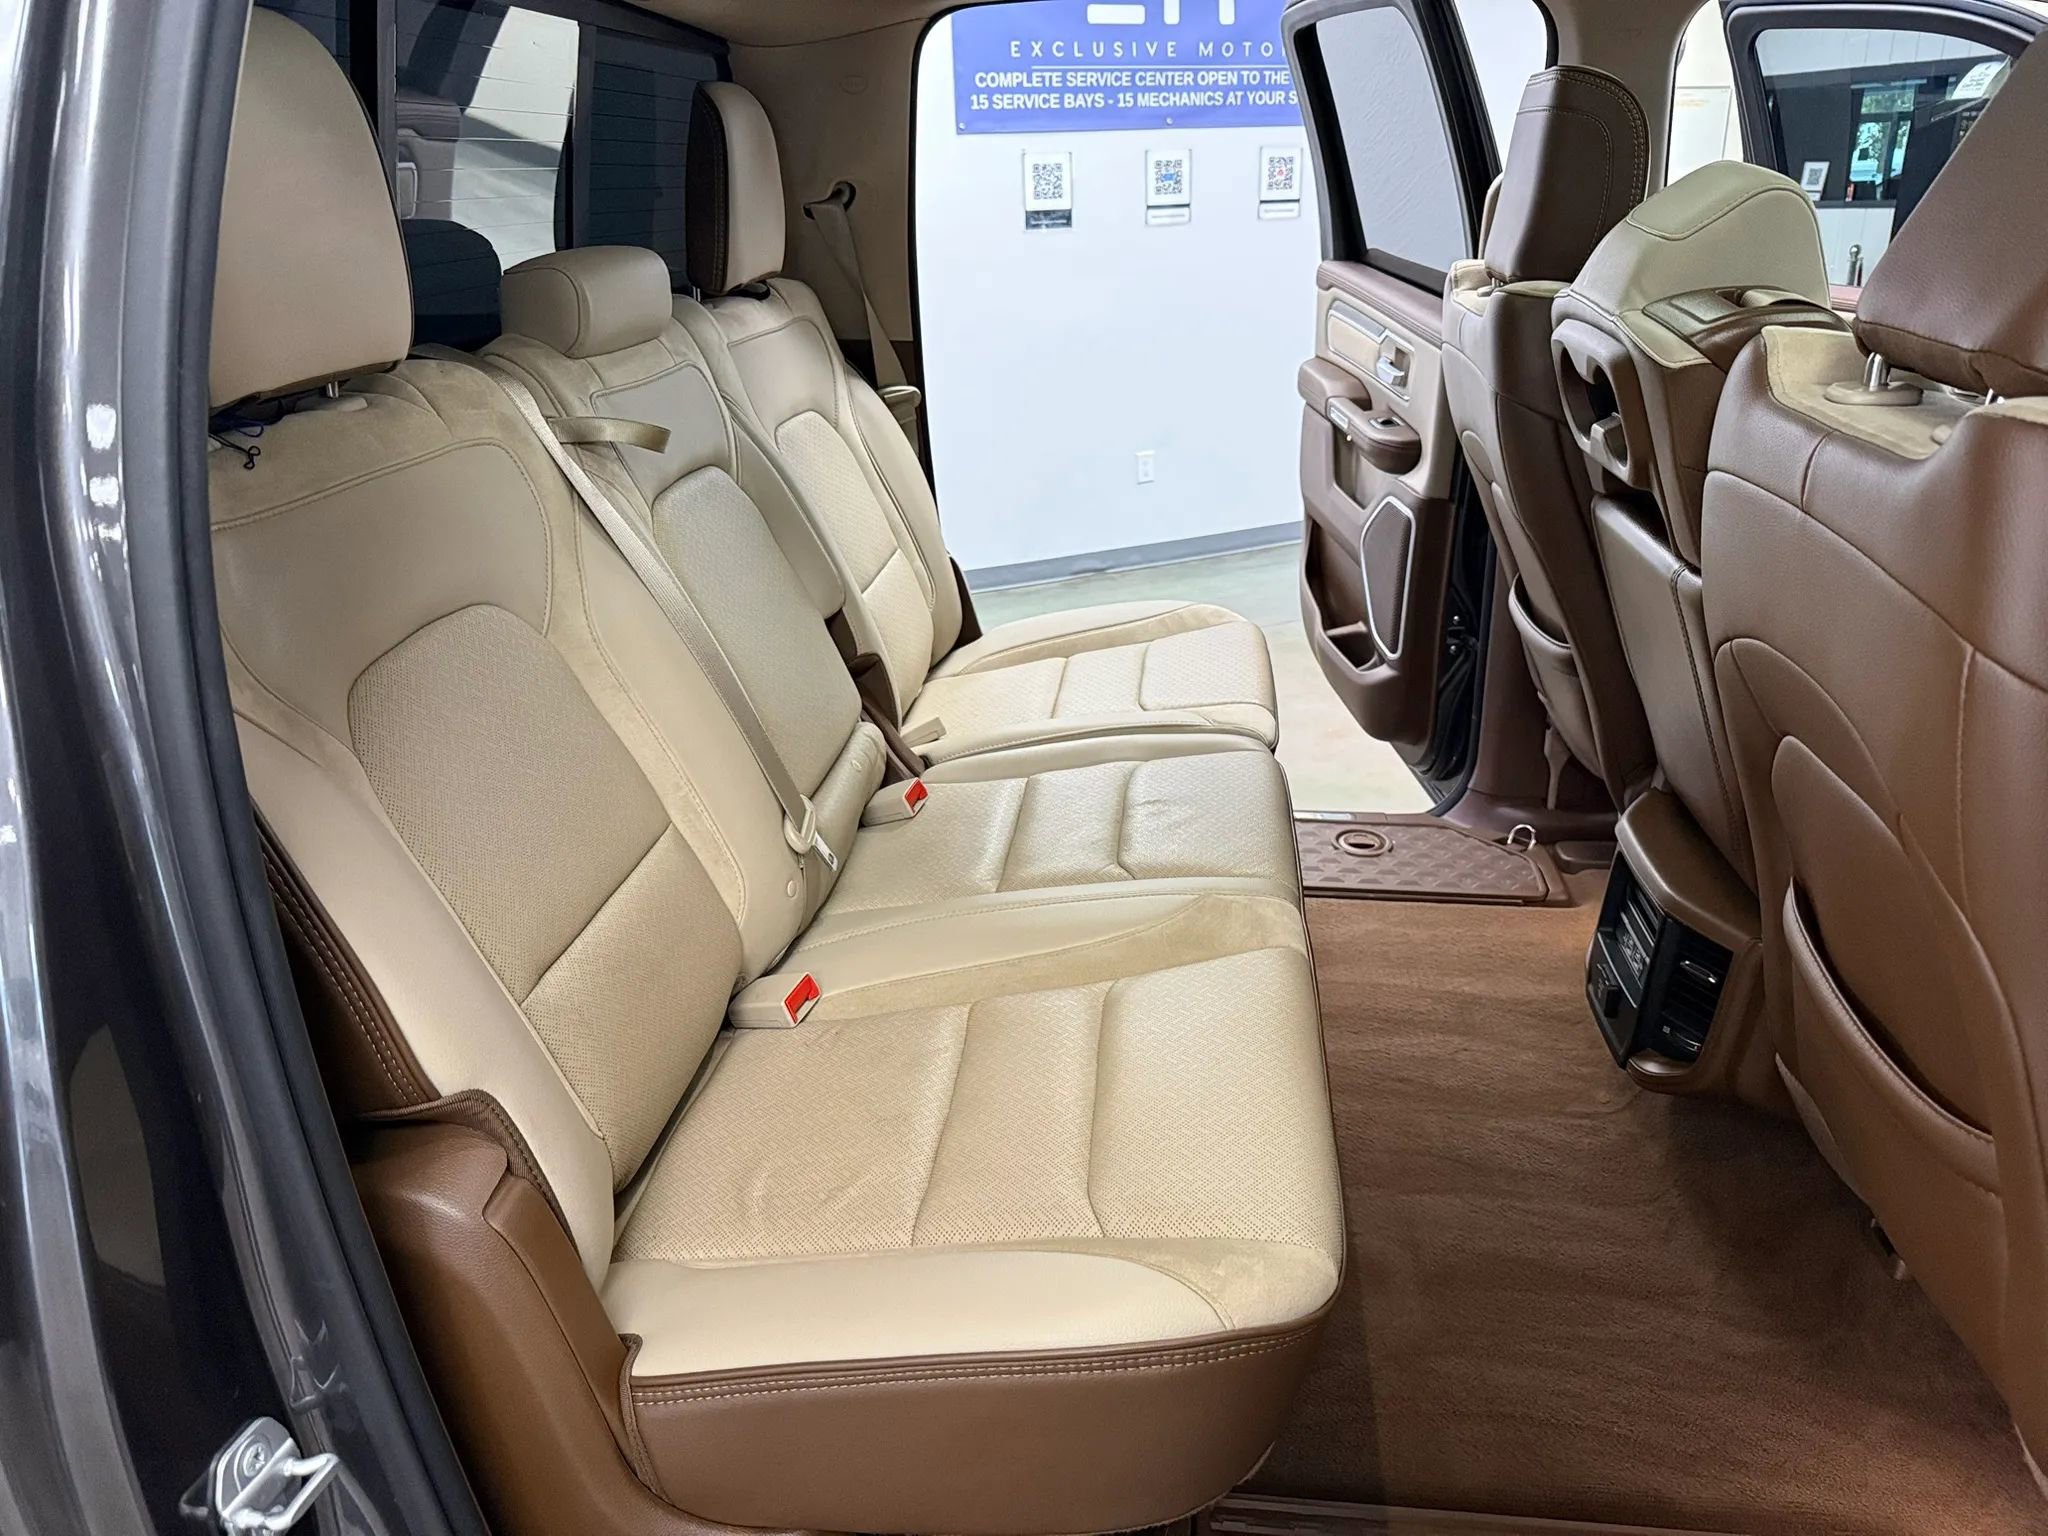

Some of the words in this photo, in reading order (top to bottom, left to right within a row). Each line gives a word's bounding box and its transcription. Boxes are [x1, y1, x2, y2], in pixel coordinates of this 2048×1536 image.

[1010, 41, 1177, 58] EXCLUSIVE
[1198, 41, 1286, 57] MOTO
[974, 71, 1063, 88] COMPLETE
[1066, 71, 1132, 87] SERVICE
[1135, 70, 1194, 86] CENTER
[1197, 70, 1237, 85] OPEN
[1241, 70, 1260, 85] TO
[1263, 70, 1290, 84] THE
[970, 93, 989, 109] 15
[992, 93, 1061, 109] SERVICE
[1063, 92, 1105, 108] BAYS
[1117, 92, 1134, 107] 15
[1136, 91, 1223, 107] MECHANICS
[1225, 90, 1244, 105] AT
[1246, 90, 1286, 105] YOUR
